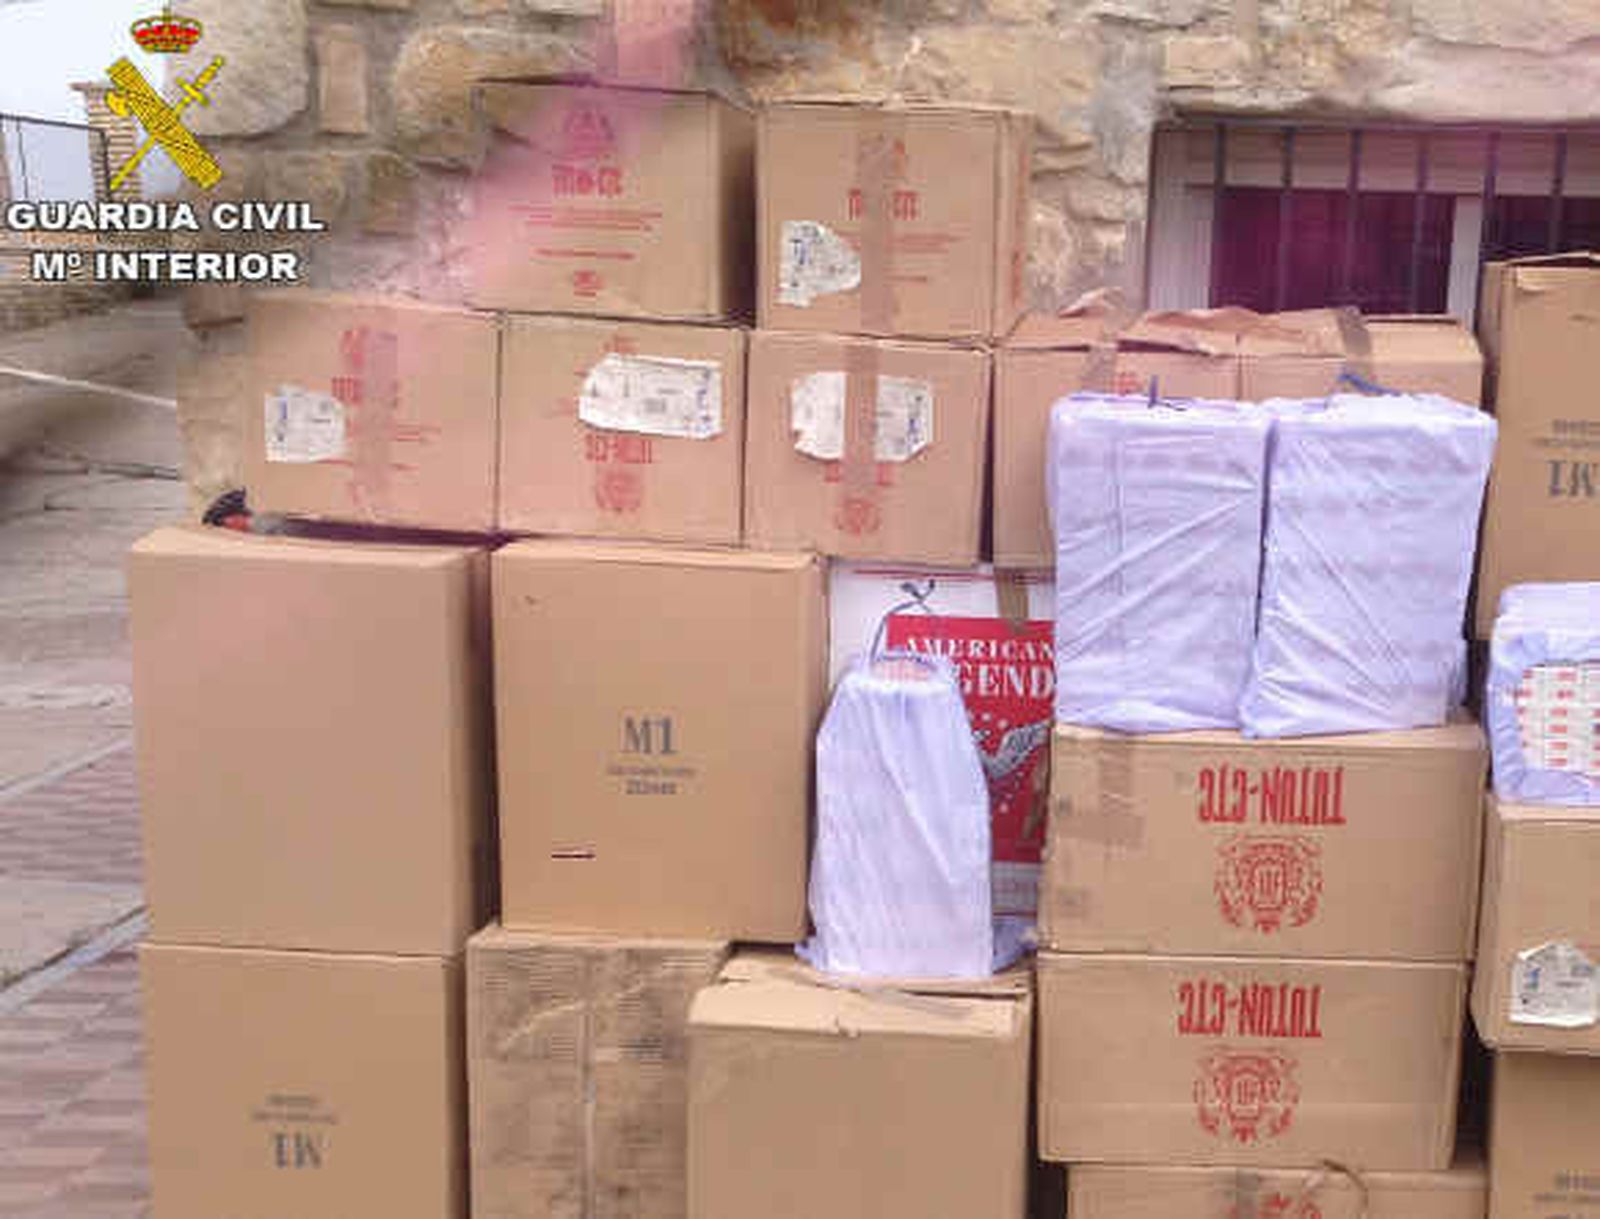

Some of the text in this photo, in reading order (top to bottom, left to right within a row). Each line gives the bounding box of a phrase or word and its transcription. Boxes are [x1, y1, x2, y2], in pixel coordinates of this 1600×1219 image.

[905, 637, 1054, 662] AMERICAN
[620, 716, 677, 755] M1
[1198, 763, 1346, 825] TUTUN-CTC
[1178, 979, 1322, 1038] TUTUN-CTC
